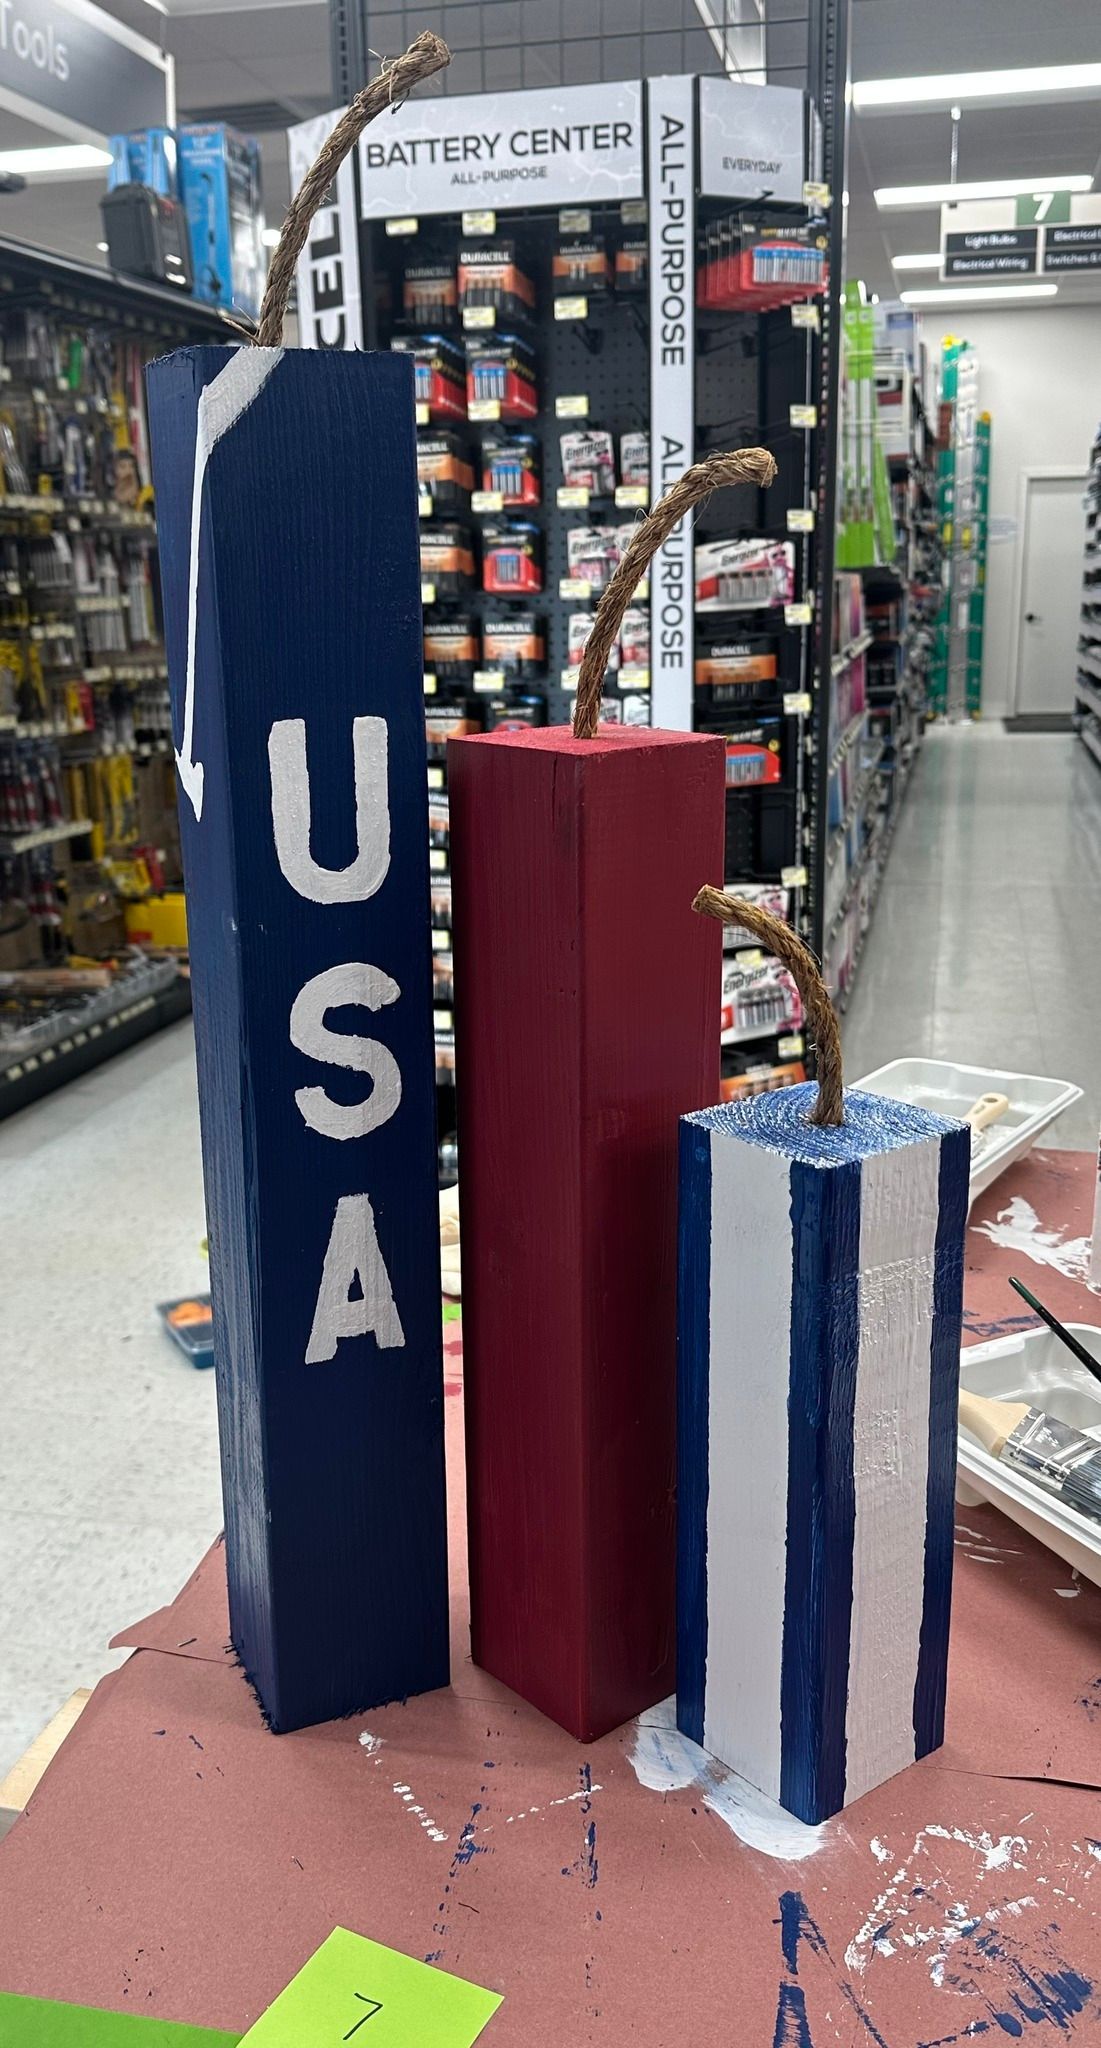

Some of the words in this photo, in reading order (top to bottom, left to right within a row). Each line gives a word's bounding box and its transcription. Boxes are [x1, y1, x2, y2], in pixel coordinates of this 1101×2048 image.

[0, 0, 70, 81] Tools
[367, 132, 501, 169] BATTERY
[510, 121, 633, 156] CENTER
[451, 166, 548, 185] ALL-PURPOSE
[722, 156, 782, 174] EVERYDAY
[1033, 193, 1054, 221] 7
[661, 114, 685, 366] ALL-PURPOSE
[461, 251, 511, 263] DURACELL
[485, 623, 531, 633] DURACELL
[723, 964, 768, 994] Energizer
[343, 1992, 383, 2040] 7
